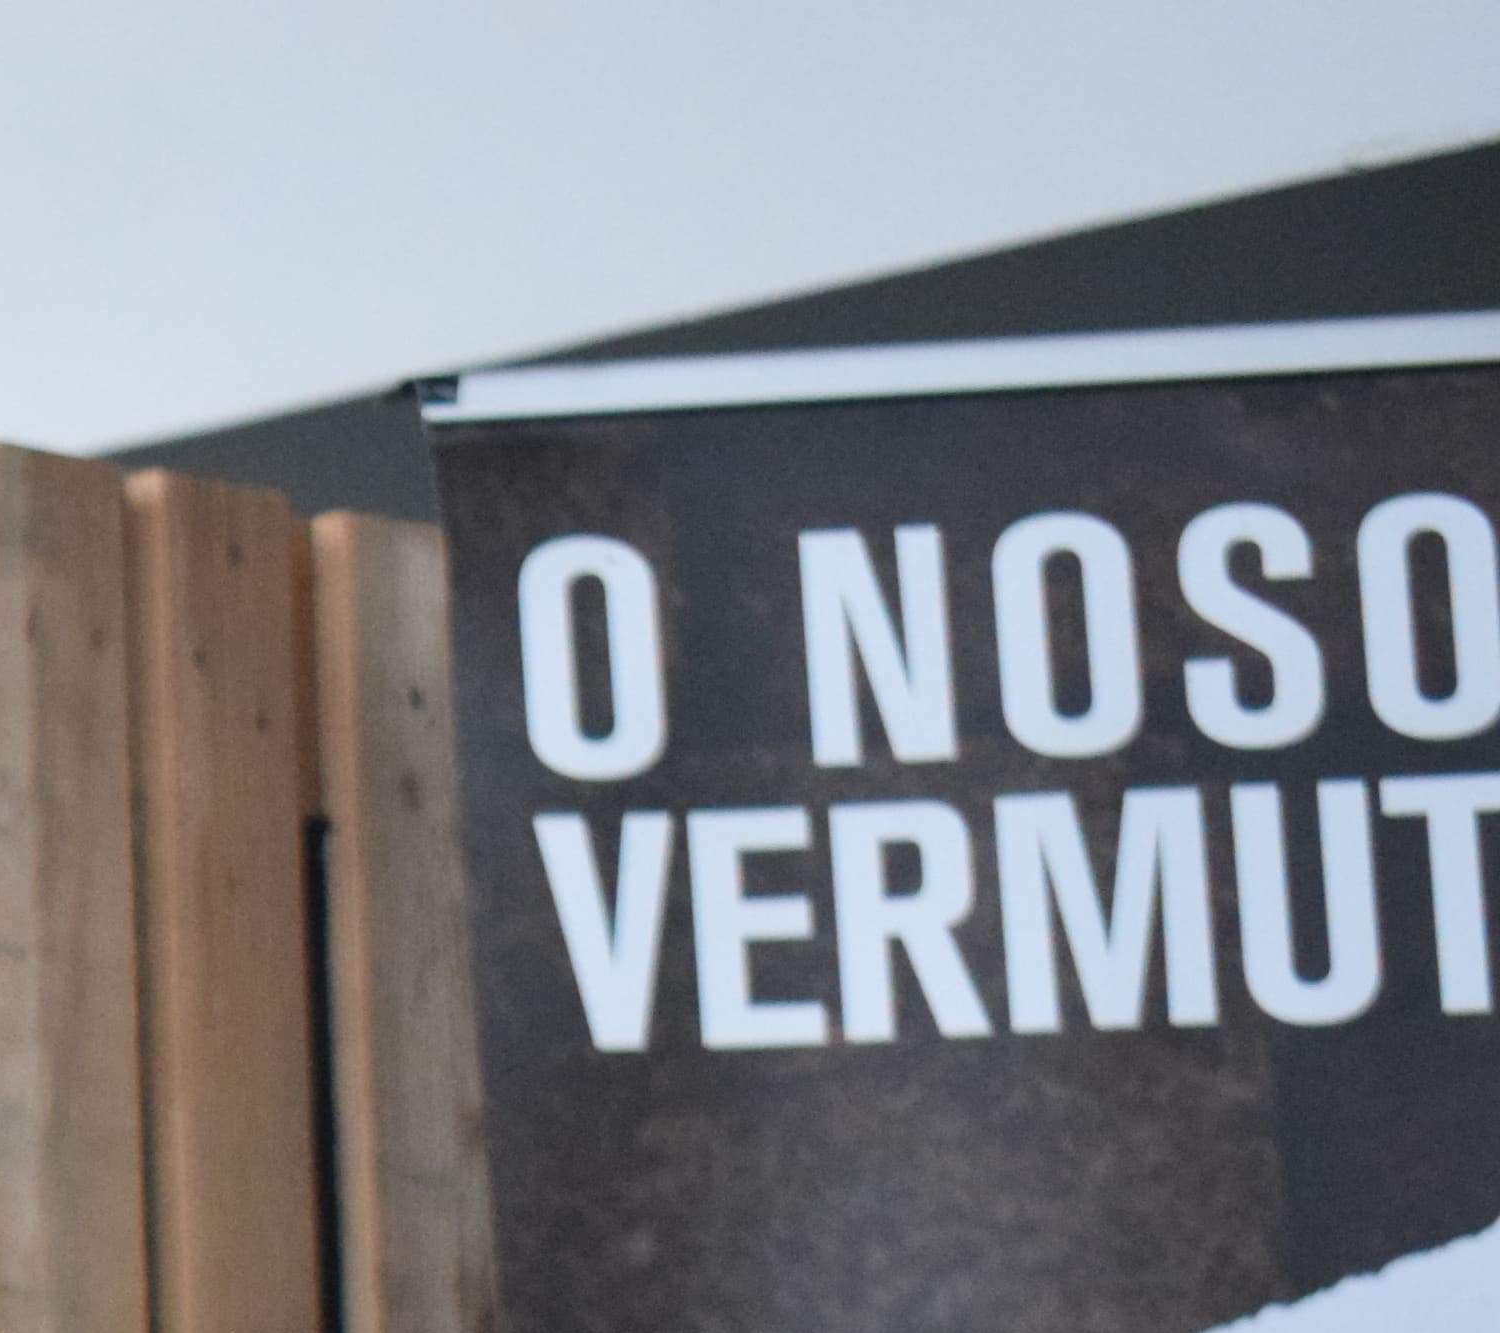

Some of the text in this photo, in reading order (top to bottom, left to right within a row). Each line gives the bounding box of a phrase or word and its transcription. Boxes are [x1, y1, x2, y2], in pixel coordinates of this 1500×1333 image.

[517, 492, 1500, 782] O NOSO
[532, 771, 1500, 1054] VERMUT
